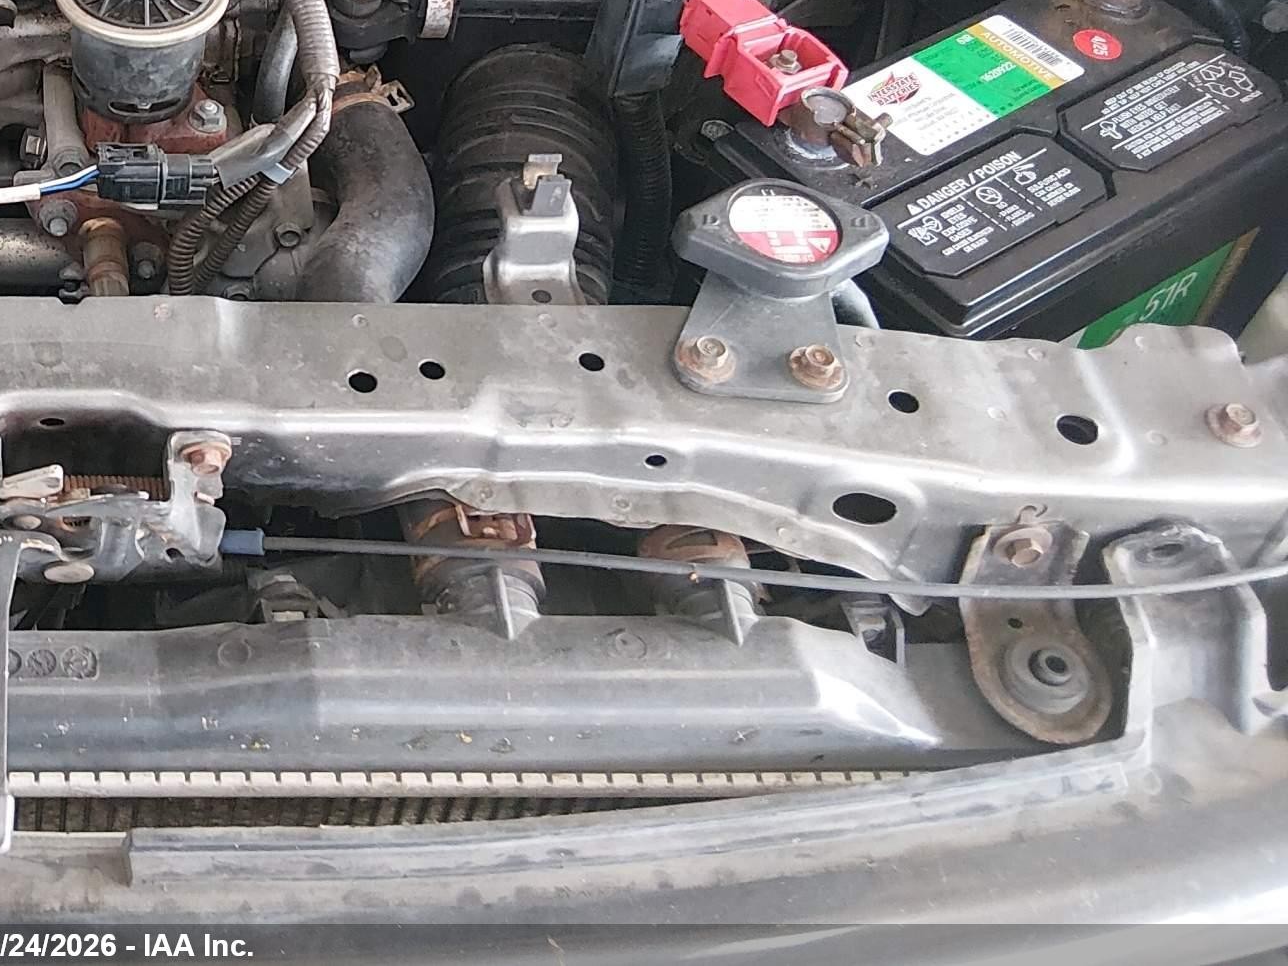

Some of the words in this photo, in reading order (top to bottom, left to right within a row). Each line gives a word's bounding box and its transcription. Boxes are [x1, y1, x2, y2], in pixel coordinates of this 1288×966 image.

[982, 32, 1054, 81] AUTOMOTIVE
[1090, 35, 1108, 56] 4/25
[867, 74, 918, 102] INTERSTATE
[877, 81, 921, 106] BATTERIES
[1112, 110, 1133, 124] FLUSH
[1129, 103, 1147, 115] EYES
[916, 178, 971, 210] DANGER
[974, 150, 1023, 180] POISON
[1139, 271, 1198, 322] 51R
